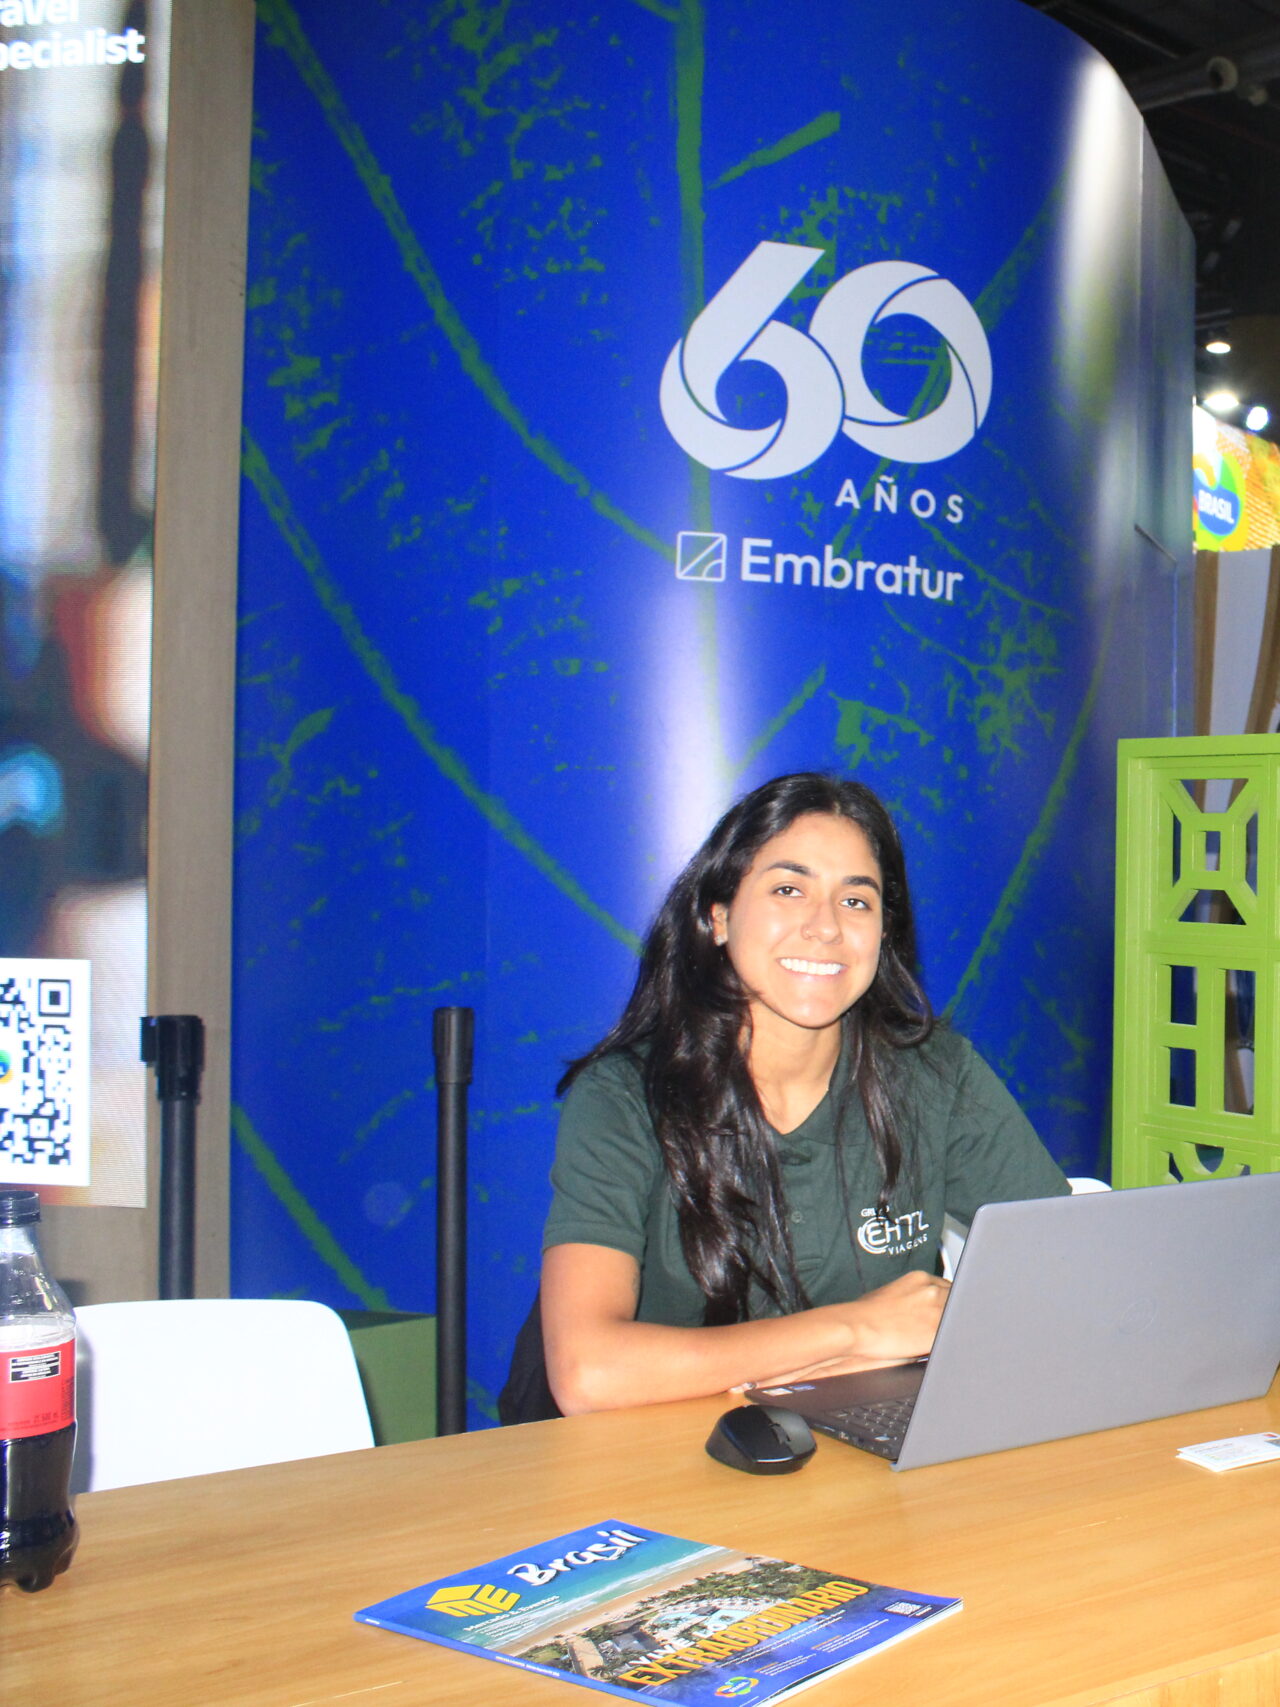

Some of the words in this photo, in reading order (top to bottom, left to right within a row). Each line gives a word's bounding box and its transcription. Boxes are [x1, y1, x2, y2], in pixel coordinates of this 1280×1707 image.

[0, 0, 79, 27] avel
[659, 240, 993, 481] 60
[834, 475, 965, 524] AÑOS
[739, 538, 965, 602] Embratur
[866, 1210, 930, 1247] EHTL
[886, 1233, 928, 1255] VIAGENS
[506, 1529, 648, 1586] Brasil
[617, 1581, 870, 1687] EXTRAORDINARIO
